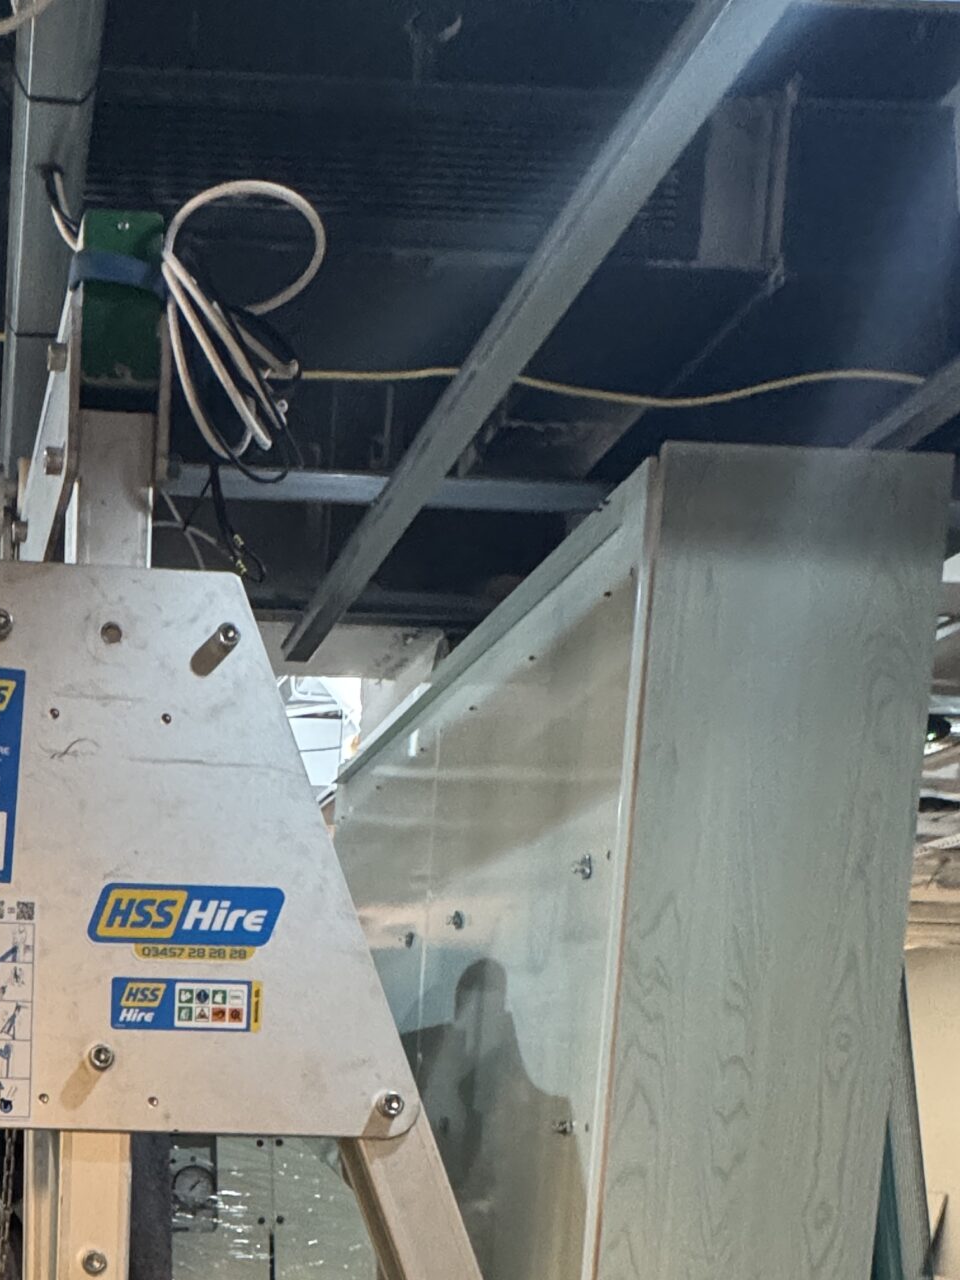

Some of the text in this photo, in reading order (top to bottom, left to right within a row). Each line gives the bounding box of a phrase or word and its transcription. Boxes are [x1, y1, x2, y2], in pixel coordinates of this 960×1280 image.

[106, 898, 268, 932] HSS Hire
[142, 946, 247, 960] 03457 28 28 28
[125, 986, 161, 1002] HSS
[119, 1008, 155, 1023] Hire
